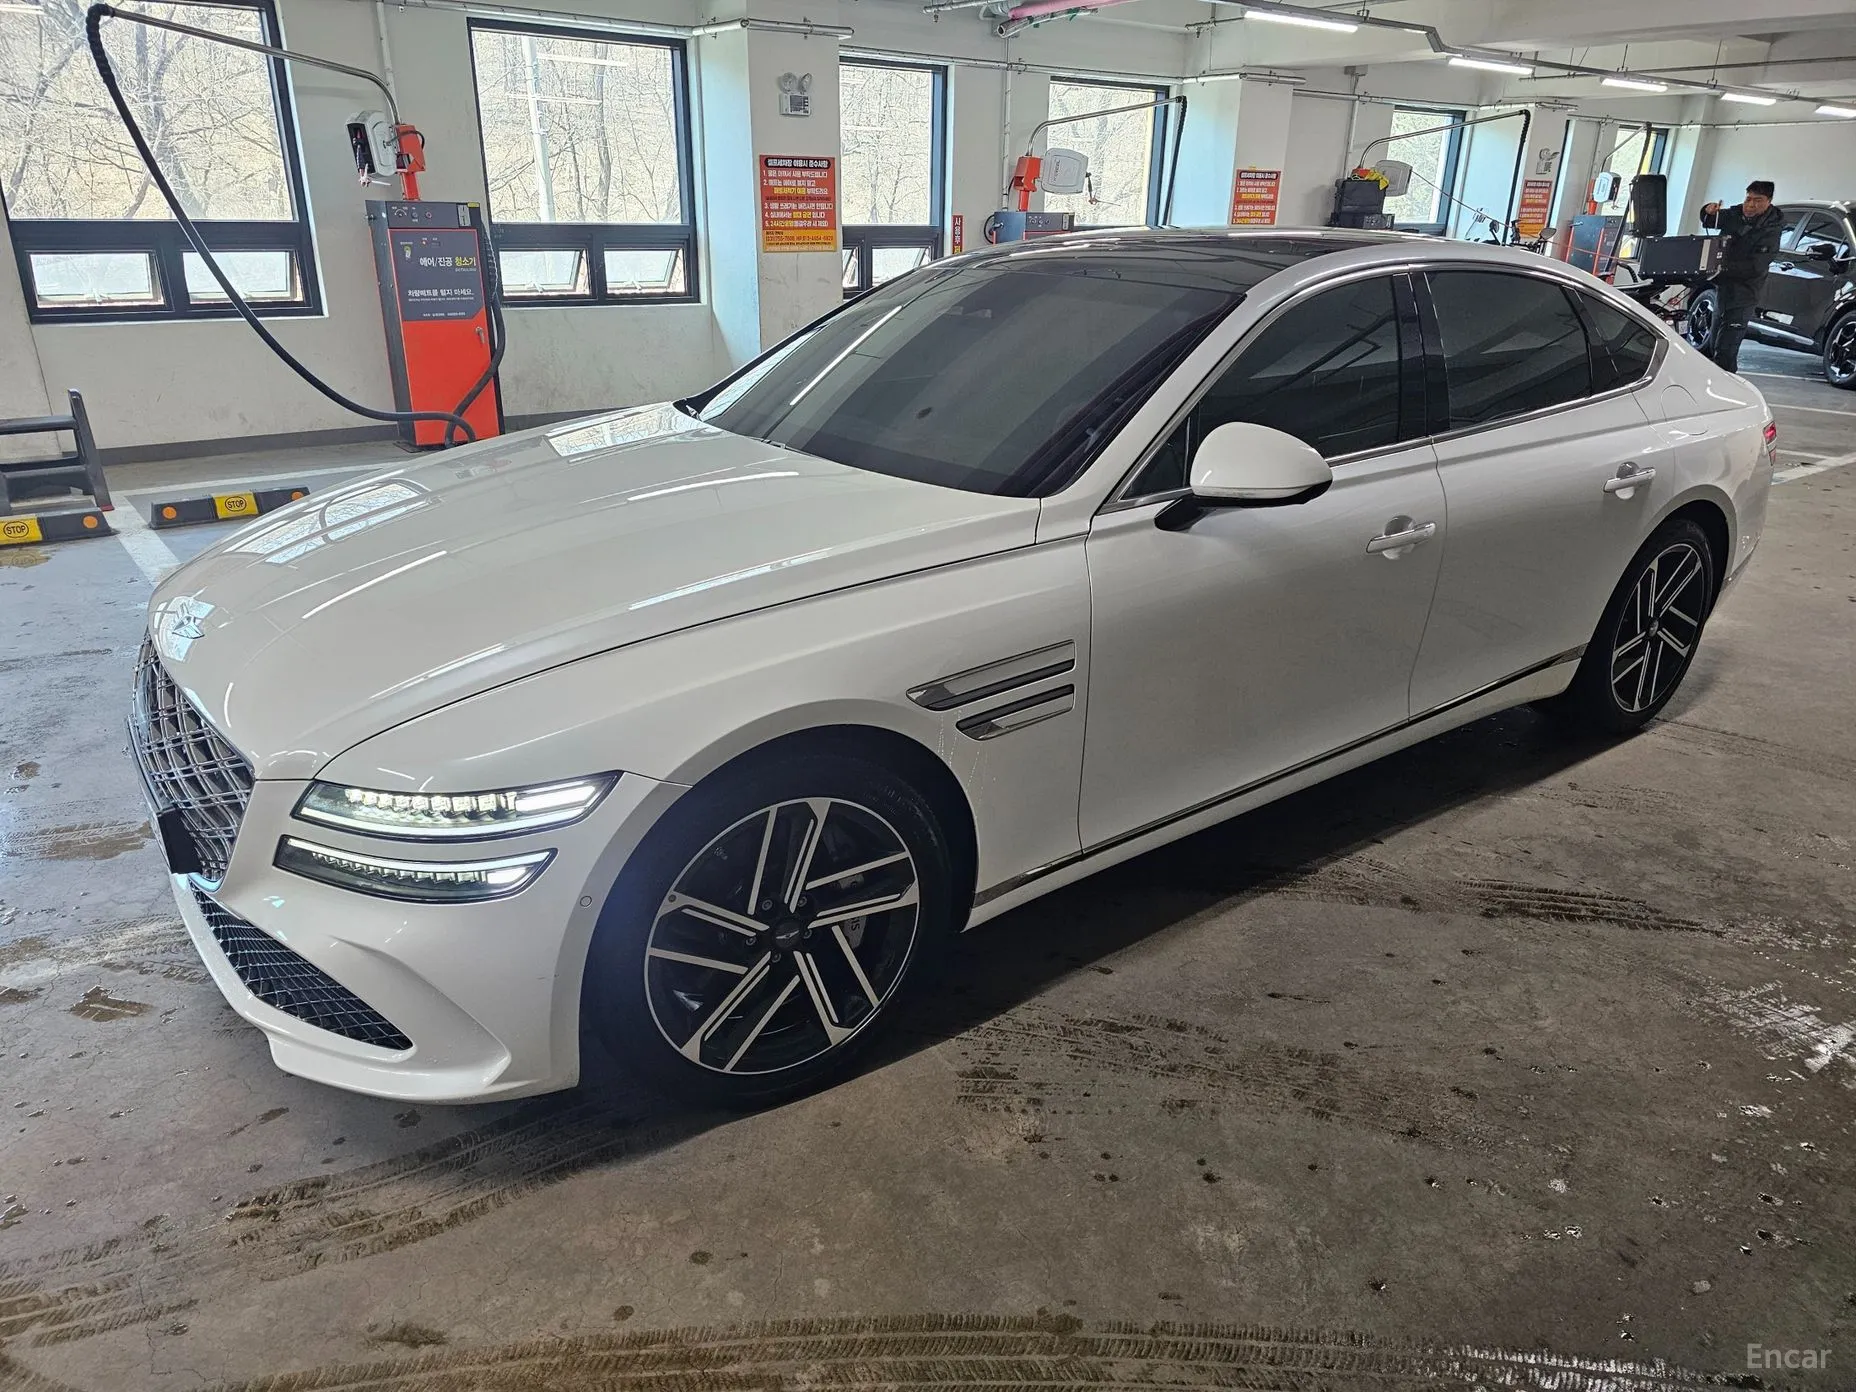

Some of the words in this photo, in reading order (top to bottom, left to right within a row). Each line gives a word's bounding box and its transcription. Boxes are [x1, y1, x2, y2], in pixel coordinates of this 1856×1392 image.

[419, 256, 453, 267] 에어/진공
[455, 256, 477, 267] 청소기
[227, 499, 244, 509] STOP
[5, 525, 26, 535] STOP
